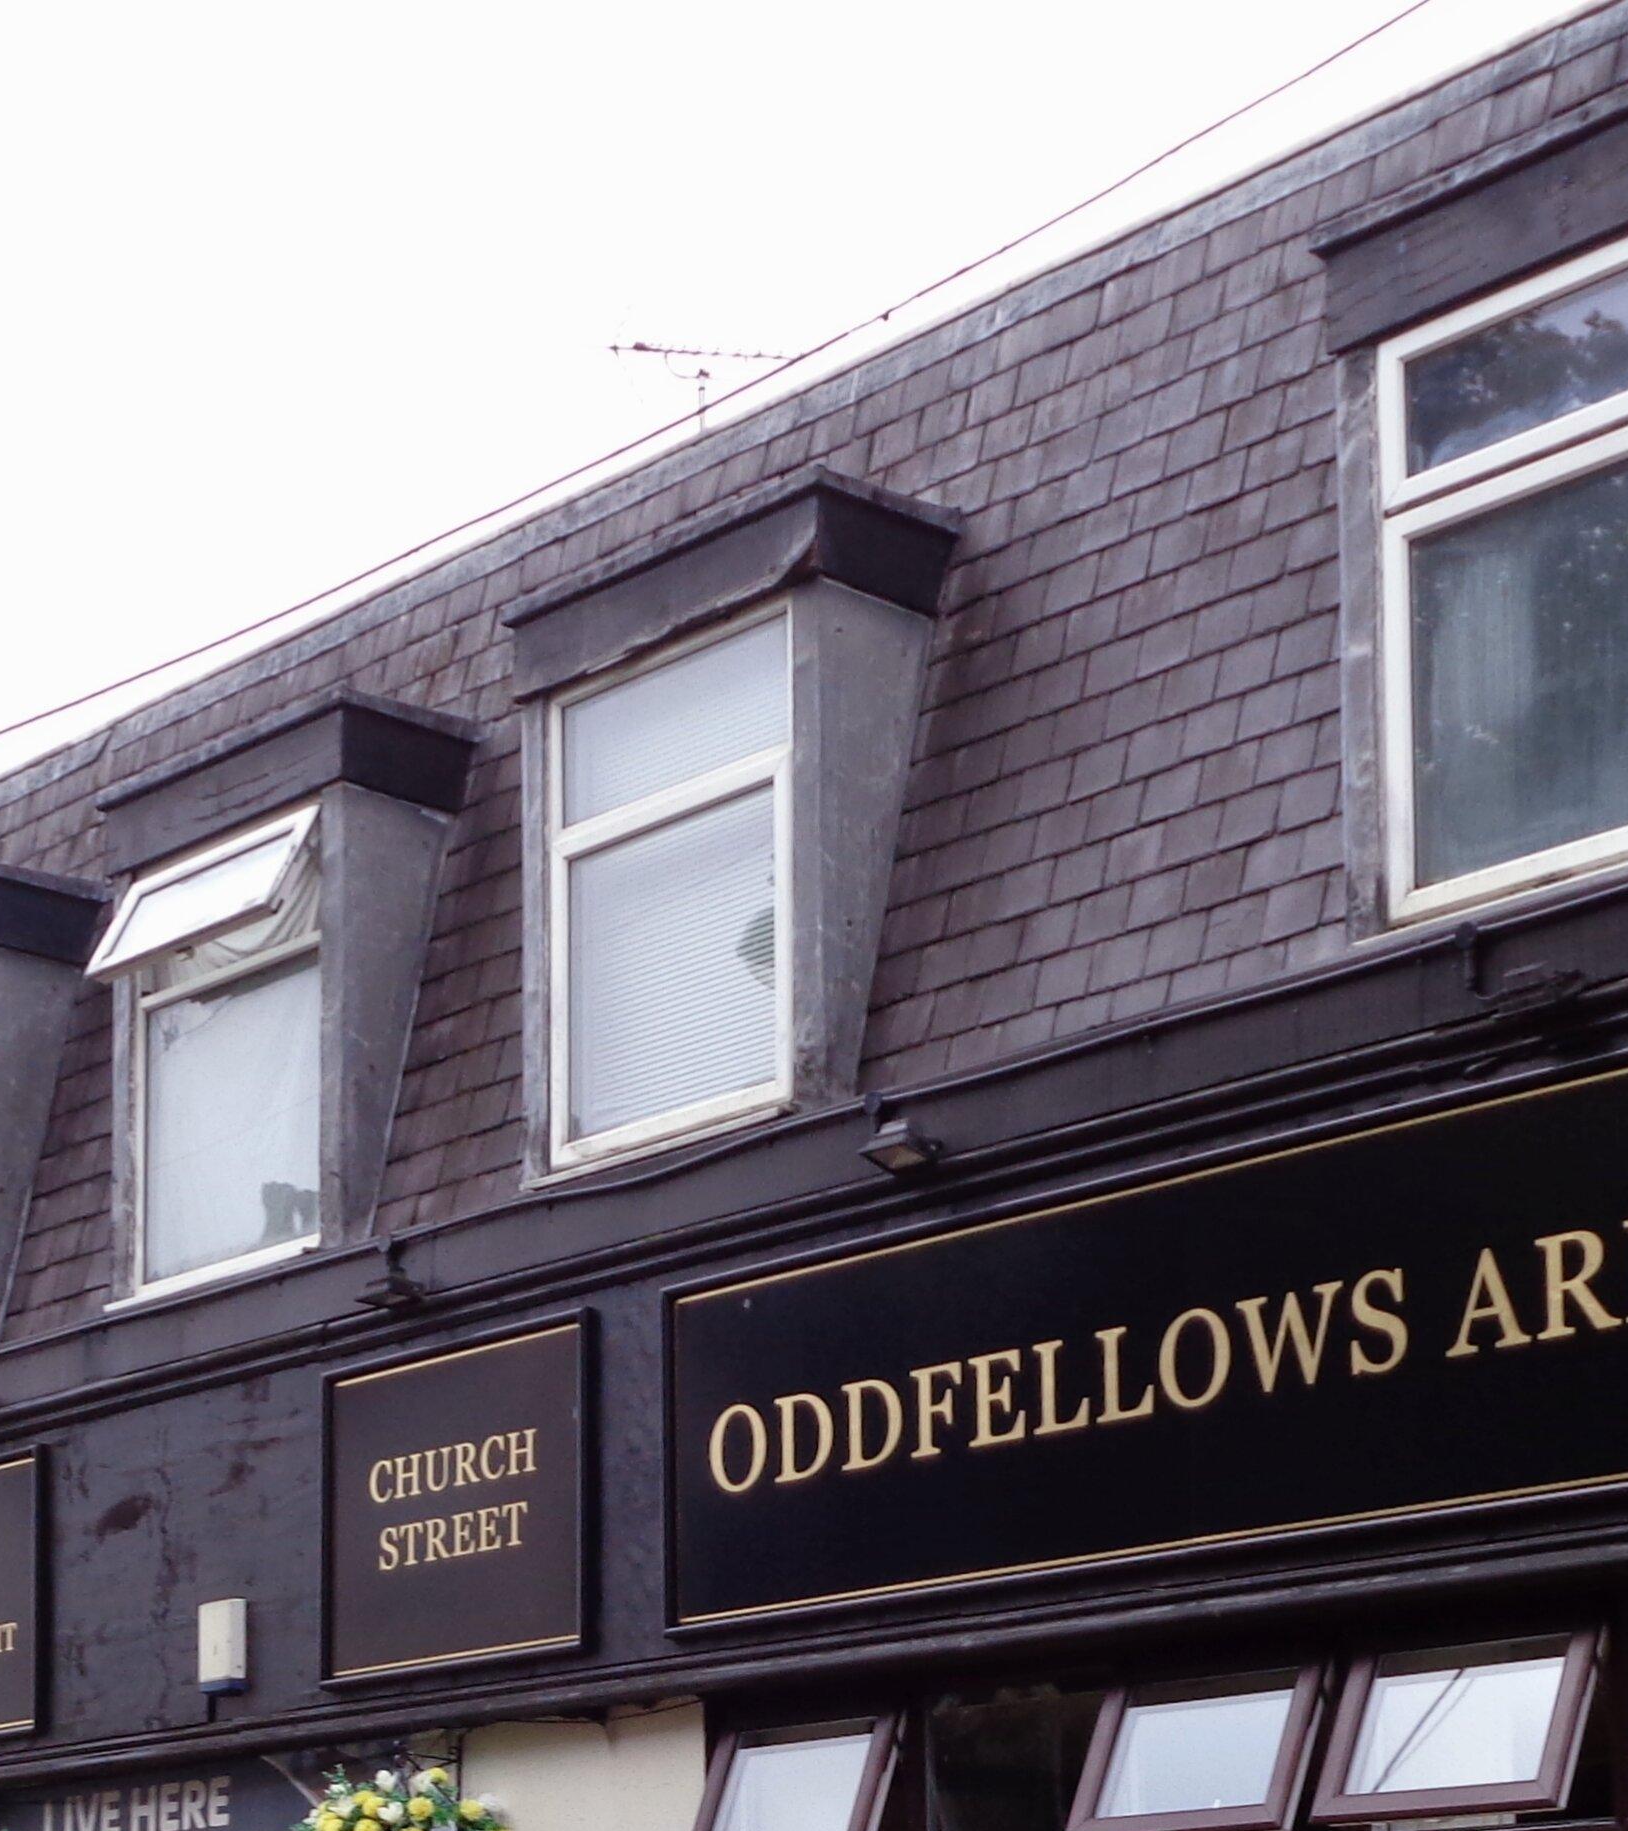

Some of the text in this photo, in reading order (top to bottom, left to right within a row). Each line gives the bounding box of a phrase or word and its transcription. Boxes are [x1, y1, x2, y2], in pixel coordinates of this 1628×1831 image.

[707, 1268, 1408, 1493] ODDFELLOWS
[369, 1428, 537, 1503] CHURCH
[379, 1501, 528, 1571] STREET
